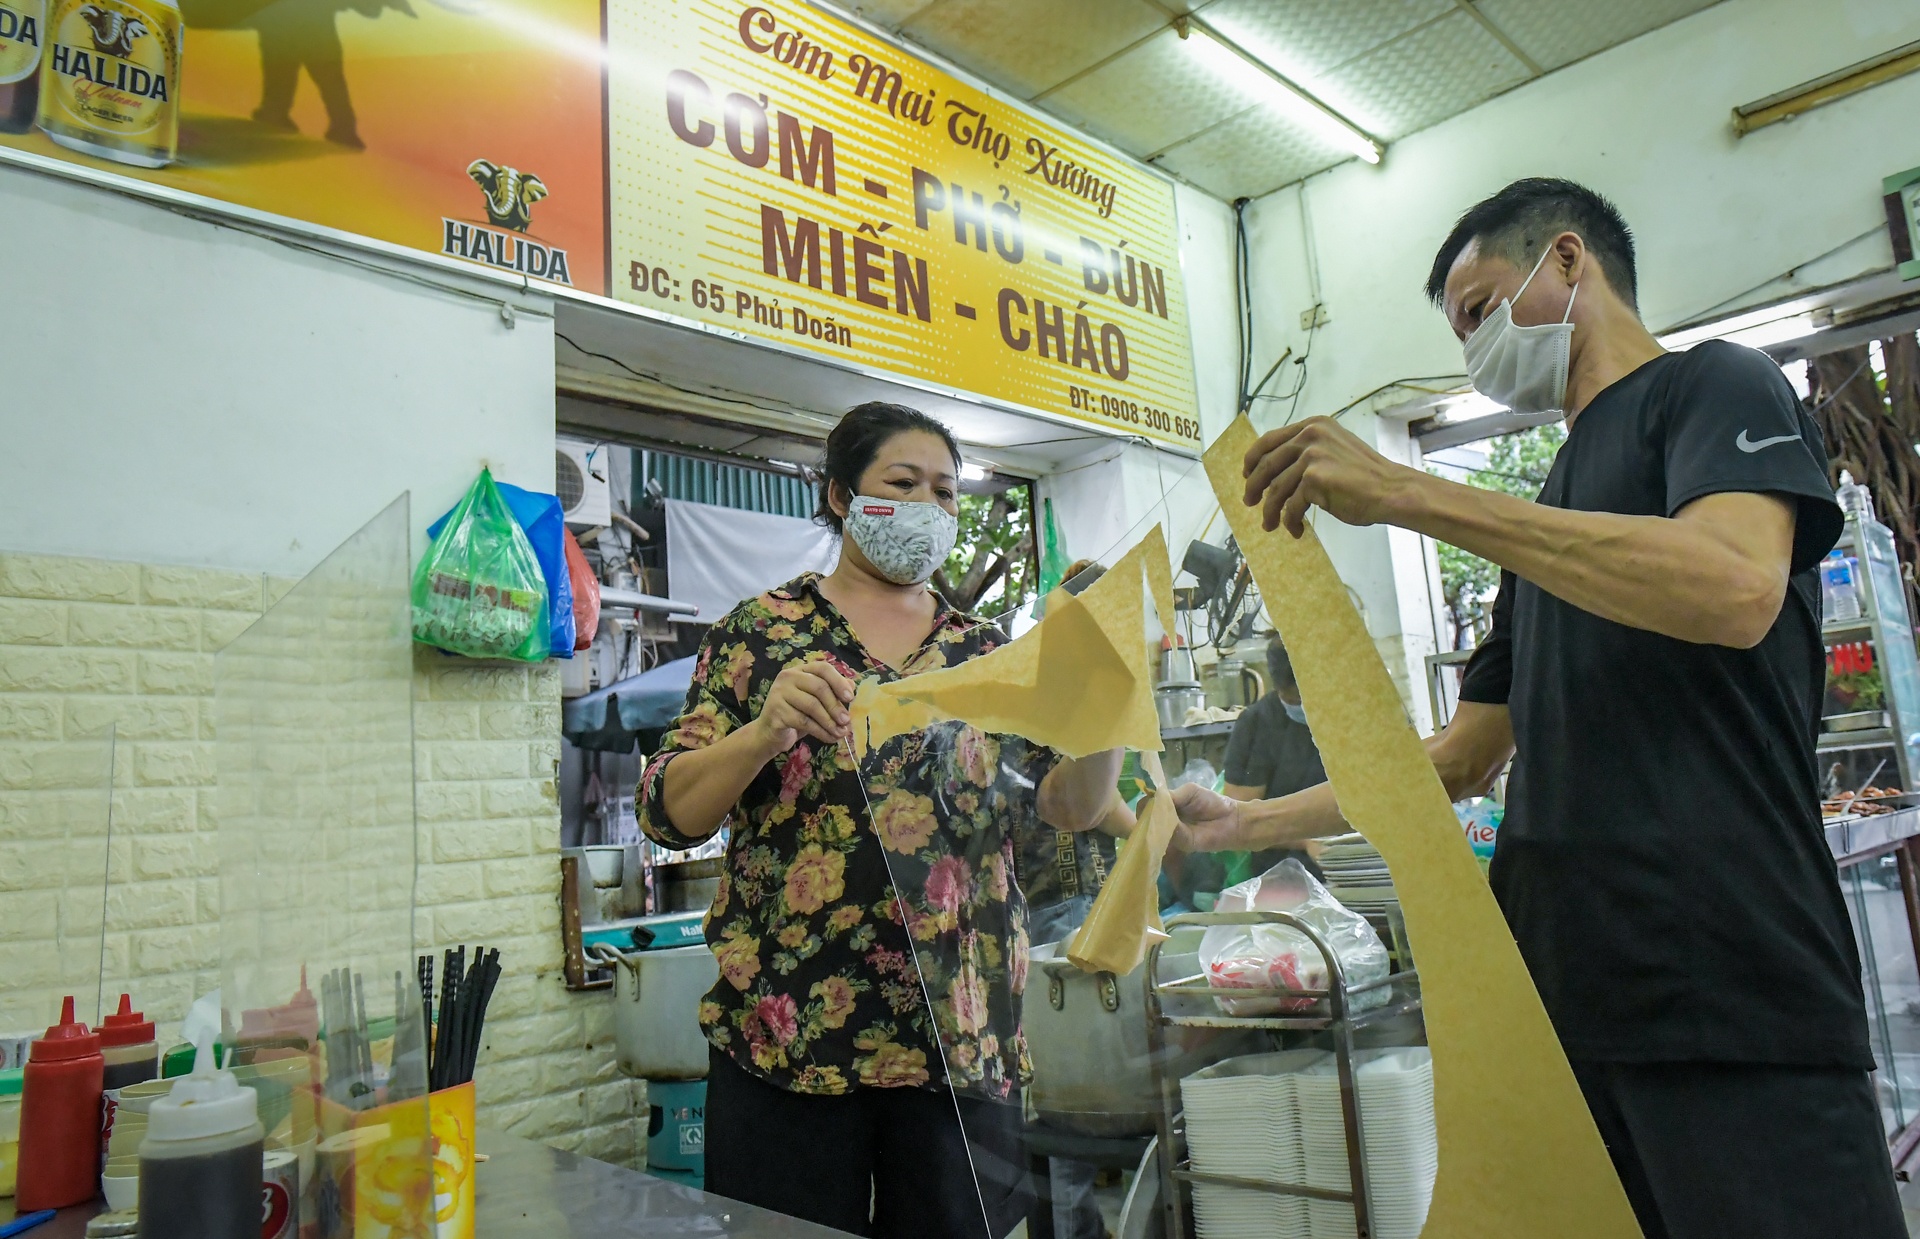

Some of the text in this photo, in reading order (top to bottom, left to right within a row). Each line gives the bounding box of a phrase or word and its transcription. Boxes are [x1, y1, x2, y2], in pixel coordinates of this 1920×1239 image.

[52, 43, 168, 103] HALIDA
[739, 7, 1116, 218] Cơm Mai Thọ Xương
[666, 69, 836, 197] CƠM
[911, 166, 1024, 265] PHỞ
[1079, 236, 1168, 320] BÚN
[442, 217, 573, 286] HALIDA
[761, 204, 931, 323] MIẾN
[997, 288, 1130, 381] CHÁO
[628, 260, 852, 348] ĐC: 65 Phủ Doãn
[1069, 385, 1201, 442] ĐT: 0908 300 662
